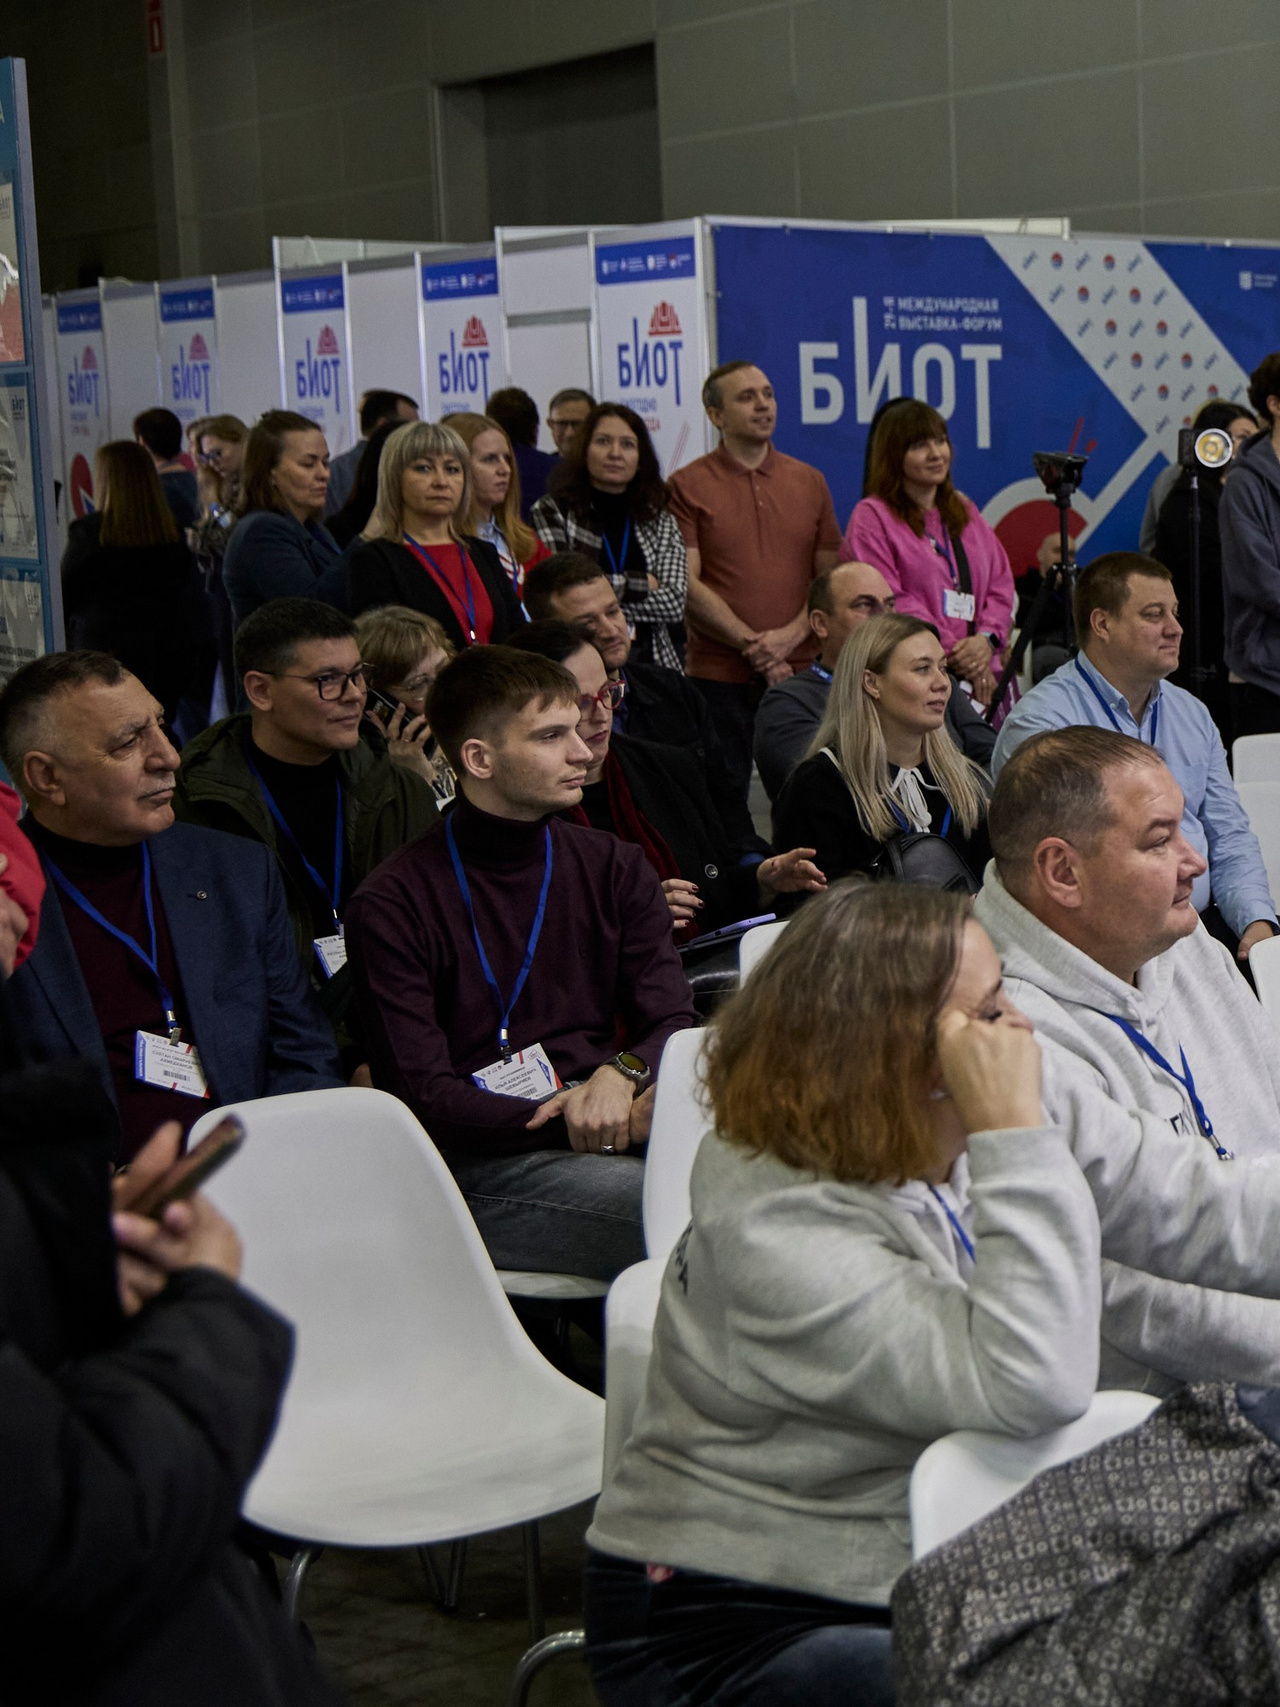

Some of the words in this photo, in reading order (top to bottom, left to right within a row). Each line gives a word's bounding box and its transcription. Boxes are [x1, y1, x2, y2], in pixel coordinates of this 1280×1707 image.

[897, 297, 999, 313] МЕЖДУНАРОДНАЯ
[898, 316, 1003, 332] ВЫСТАВКА-ФОРУМ
[68, 355, 100, 419] БИОТ
[171, 344, 210, 414] БИОТ
[296, 338, 341, 414] БИОТ
[438, 329, 490, 402] БИОТ
[617, 316, 683, 407] БИОТ
[799, 296, 1003, 449] БИОТ
